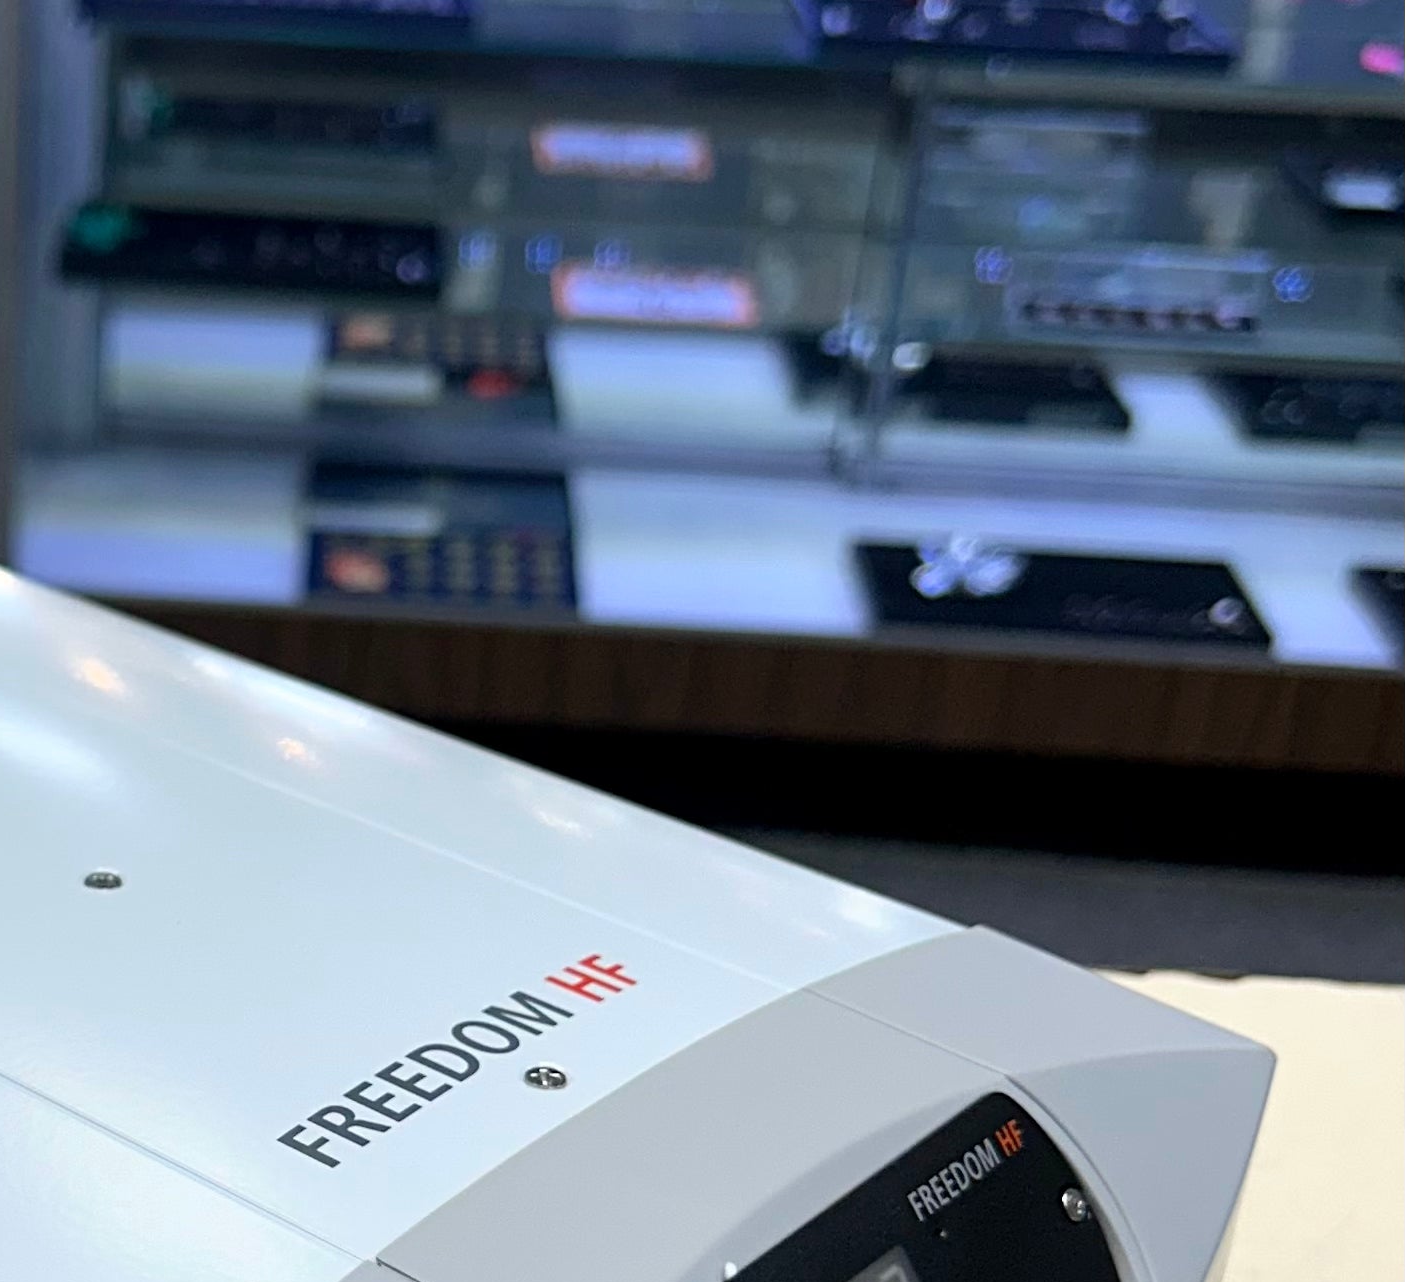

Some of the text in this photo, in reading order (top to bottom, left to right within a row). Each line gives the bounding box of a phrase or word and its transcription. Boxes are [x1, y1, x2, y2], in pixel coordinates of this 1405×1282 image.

[276, 953, 637, 1168] FREEDOM HF
[907, 1119, 1023, 1222] FREEDOM HF
